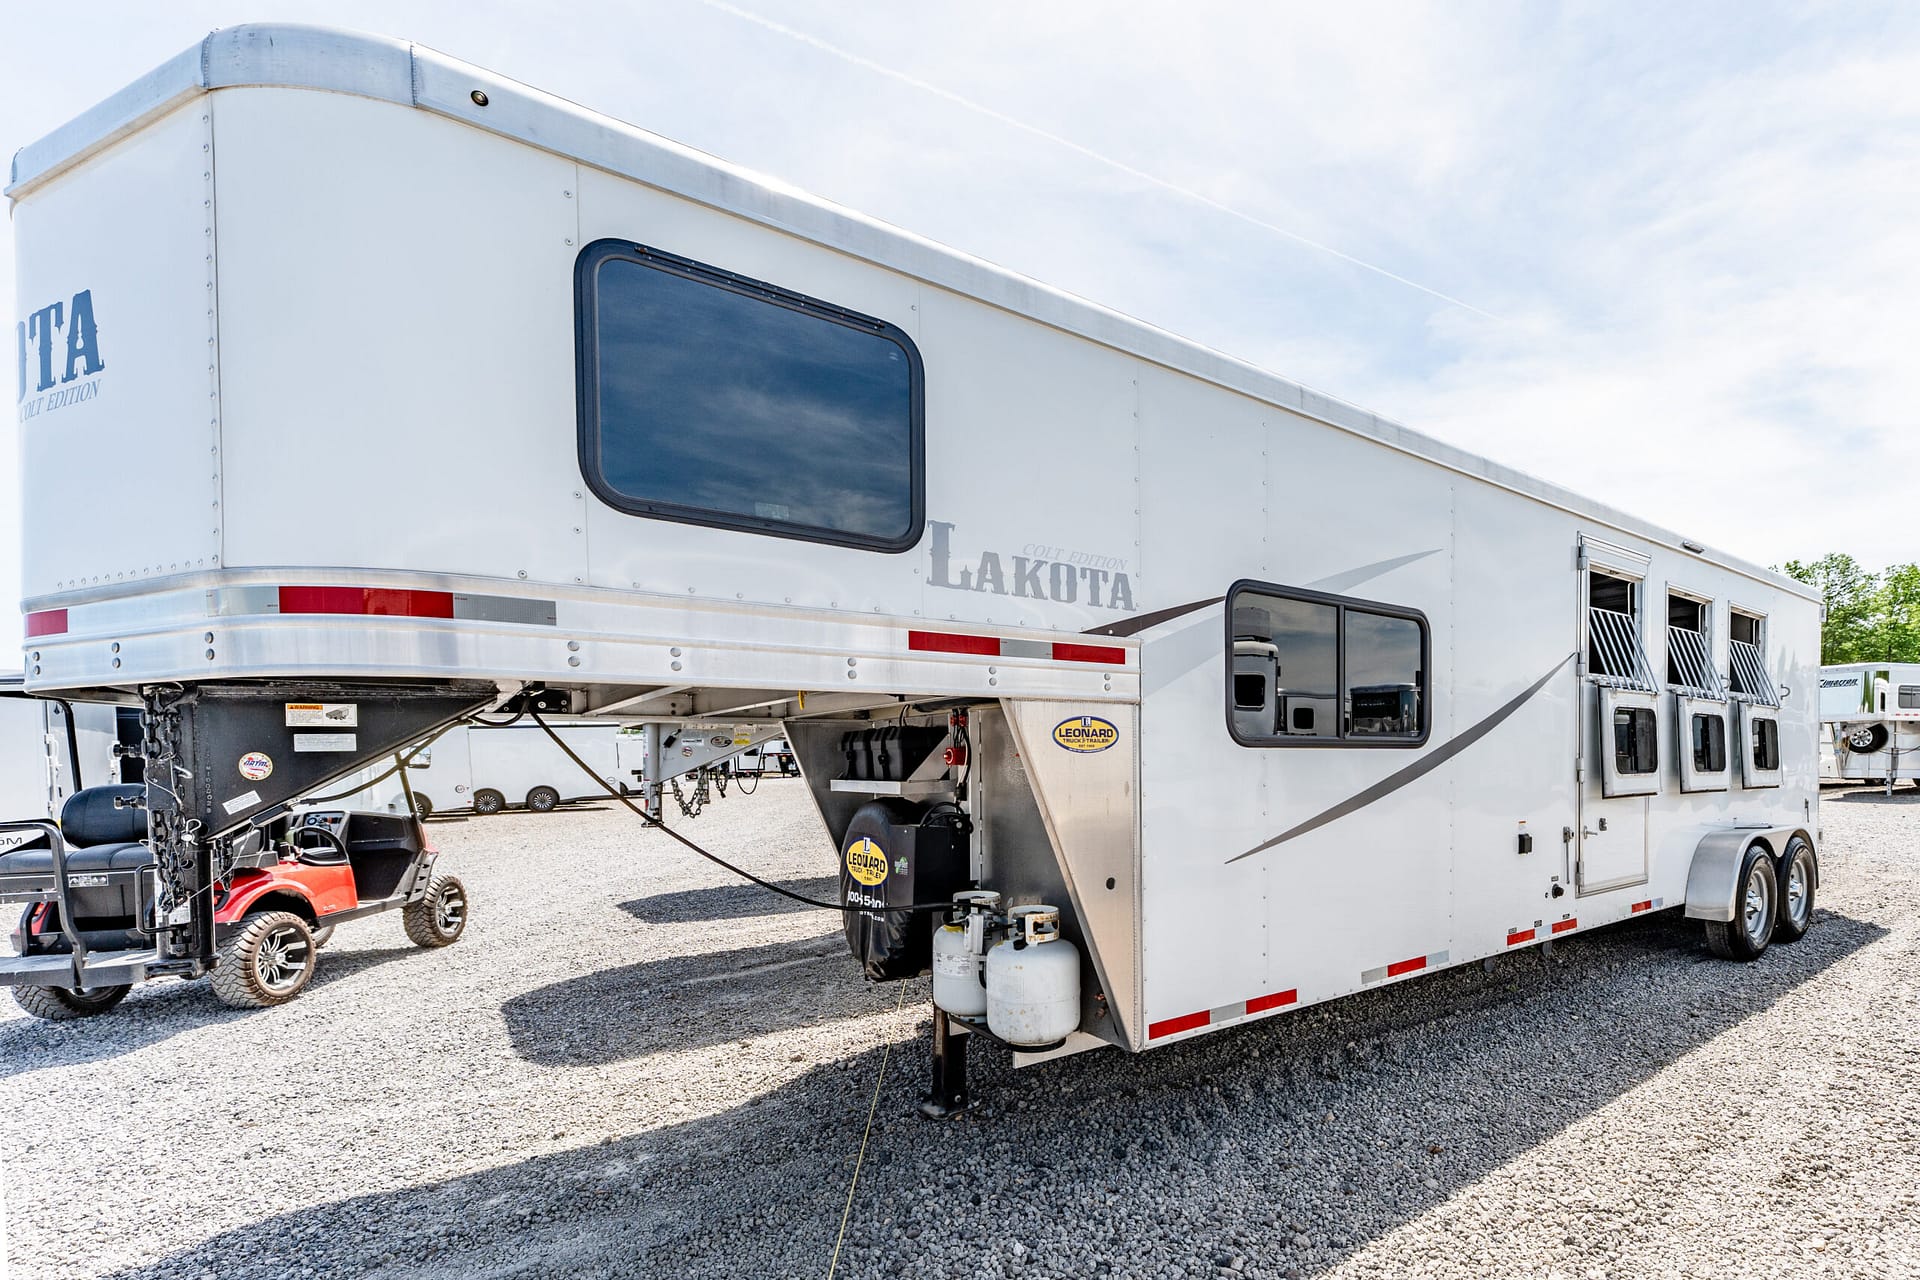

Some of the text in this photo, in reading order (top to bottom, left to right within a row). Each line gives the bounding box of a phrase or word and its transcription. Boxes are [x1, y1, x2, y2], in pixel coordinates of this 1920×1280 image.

[19, 378, 102, 424] COLT EDITION
[926, 519, 1137, 612] LAKOTA
[1022, 543, 1129, 570] COLT EDITION
[1058, 728, 1114, 738] LEONARD
